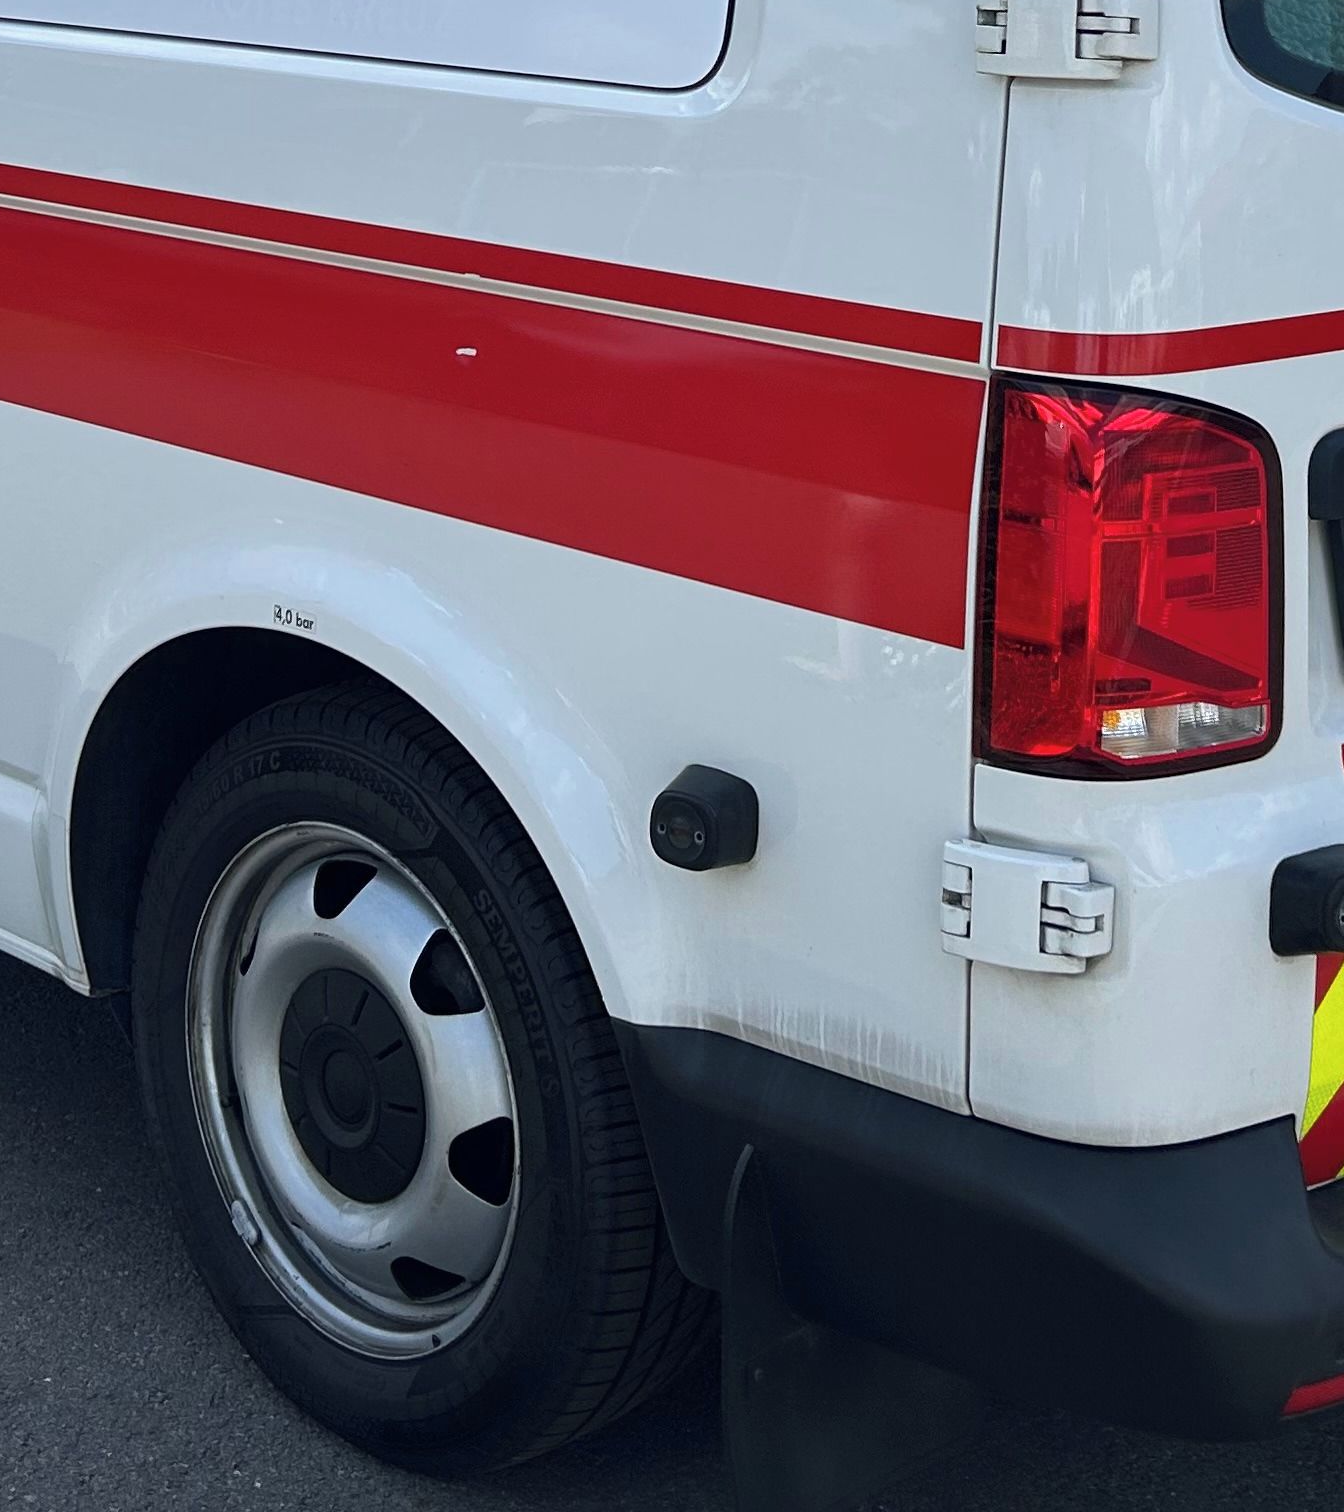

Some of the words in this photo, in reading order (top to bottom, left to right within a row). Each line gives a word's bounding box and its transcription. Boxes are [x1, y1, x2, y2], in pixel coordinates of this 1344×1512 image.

[296, 611, 313, 630] bar
[248, 754, 265, 777] 17
[270, 749, 281, 771] C
[471, 888, 554, 1066] SEMPERIT
